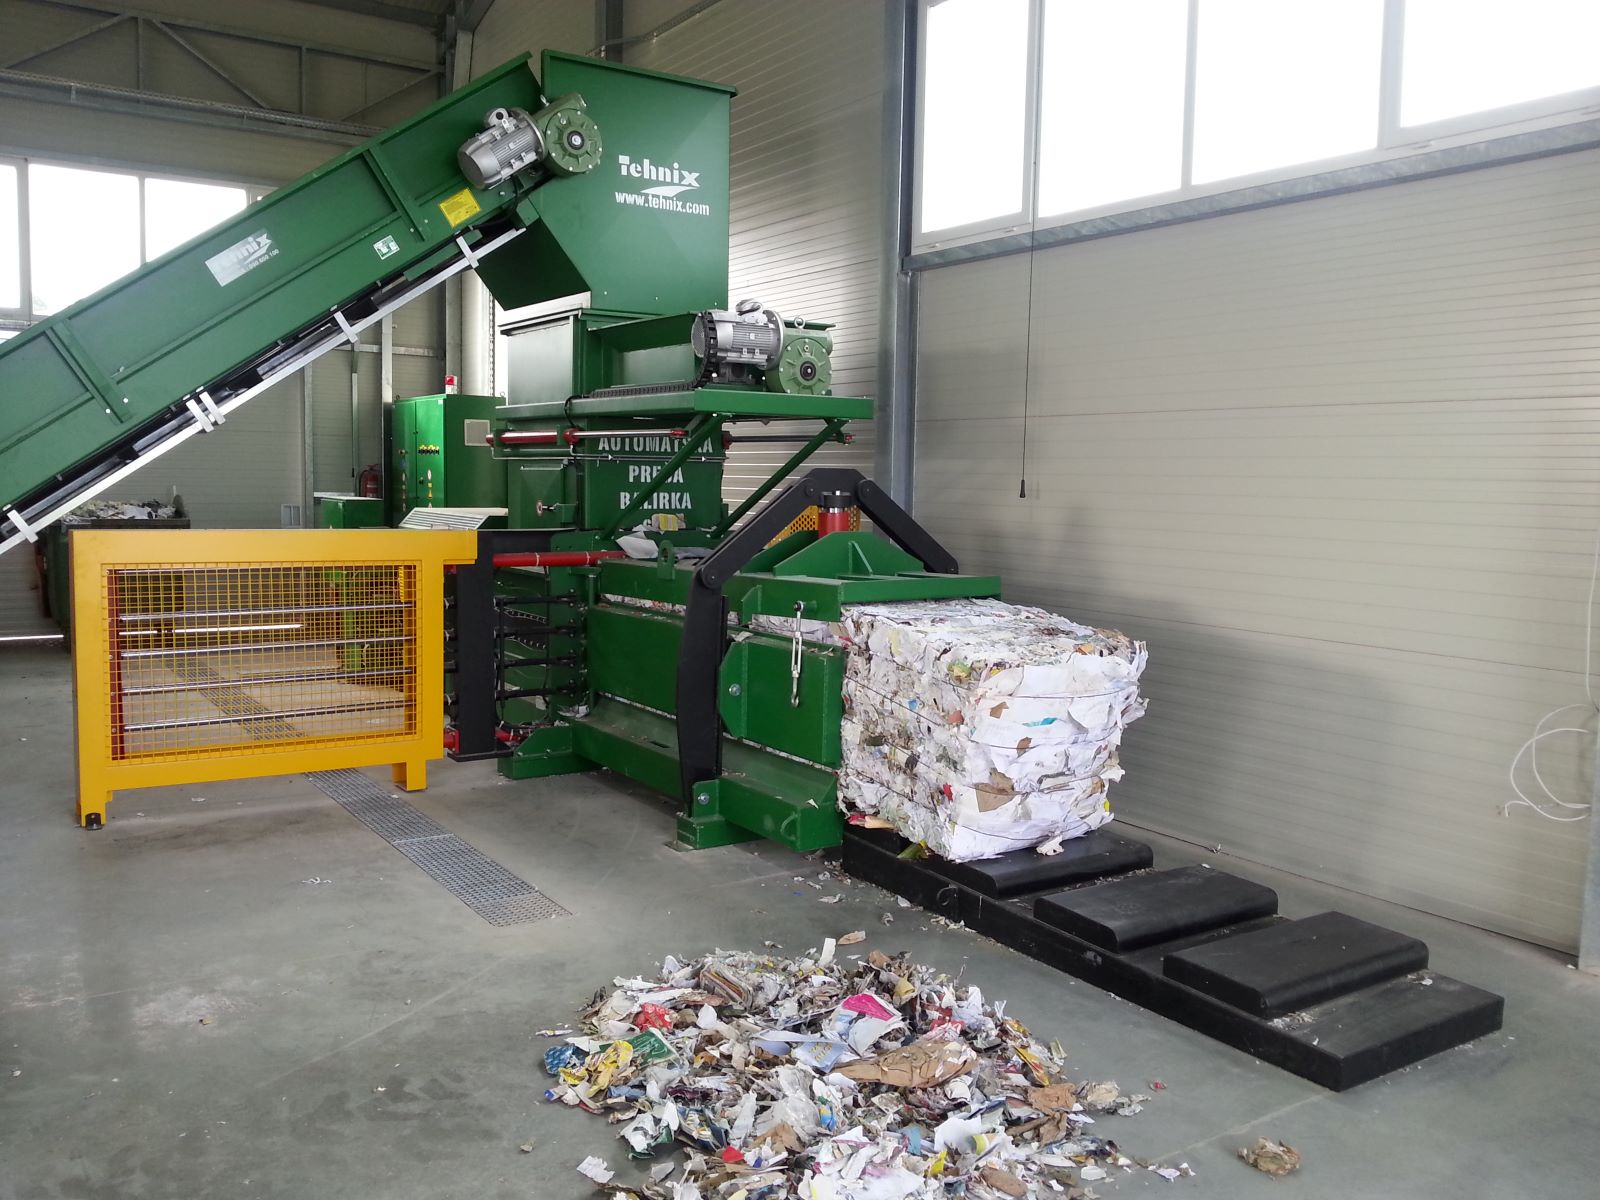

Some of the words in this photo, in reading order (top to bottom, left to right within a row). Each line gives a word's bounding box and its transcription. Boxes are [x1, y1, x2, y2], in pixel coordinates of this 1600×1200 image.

[618, 154, 700, 187] Tehnix
[615, 191, 710, 216] www.tehnix.com
[619, 491, 692, 510] BLIRKA
